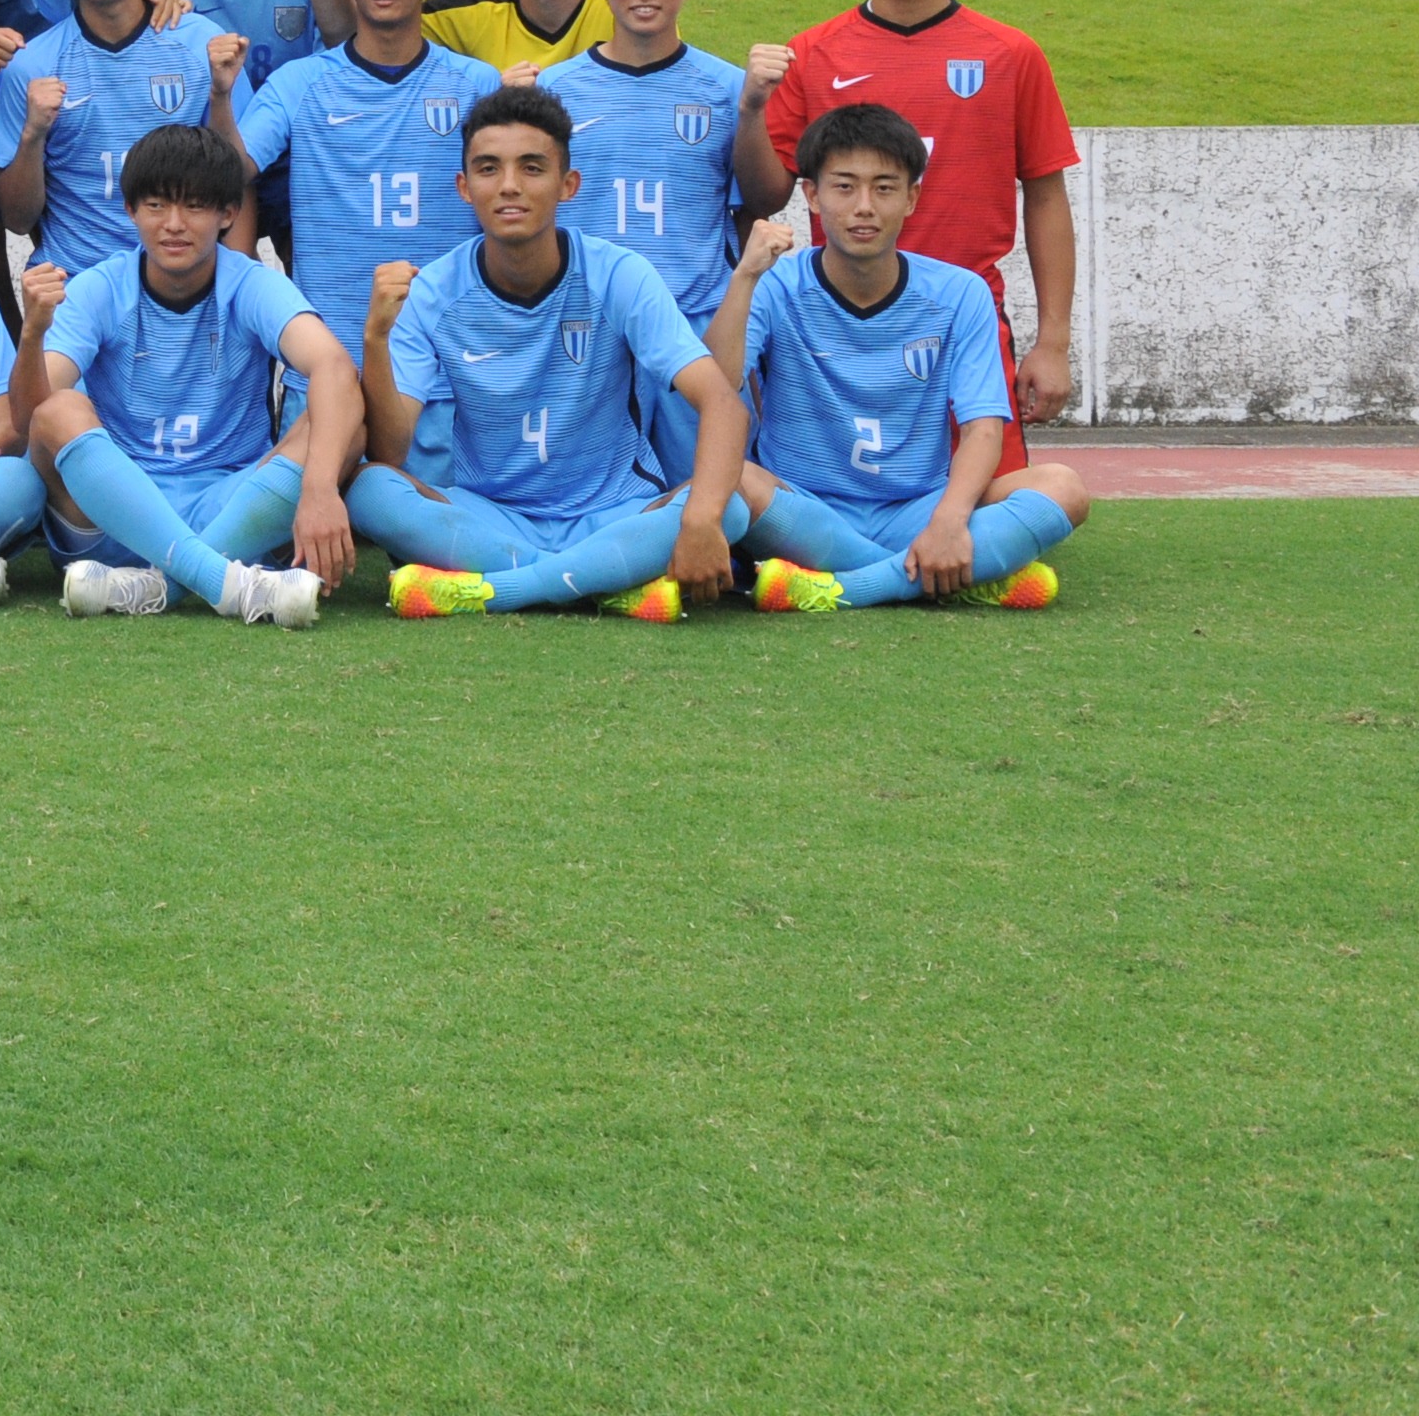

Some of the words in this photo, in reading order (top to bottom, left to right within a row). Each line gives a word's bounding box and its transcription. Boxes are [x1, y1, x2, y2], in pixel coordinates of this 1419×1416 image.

[369, 172, 419, 227] 13
[613, 178, 663, 235] 14
[153, 415, 199, 459] 12
[521, 407, 548, 463] 4
[850, 418, 882, 474] 2
